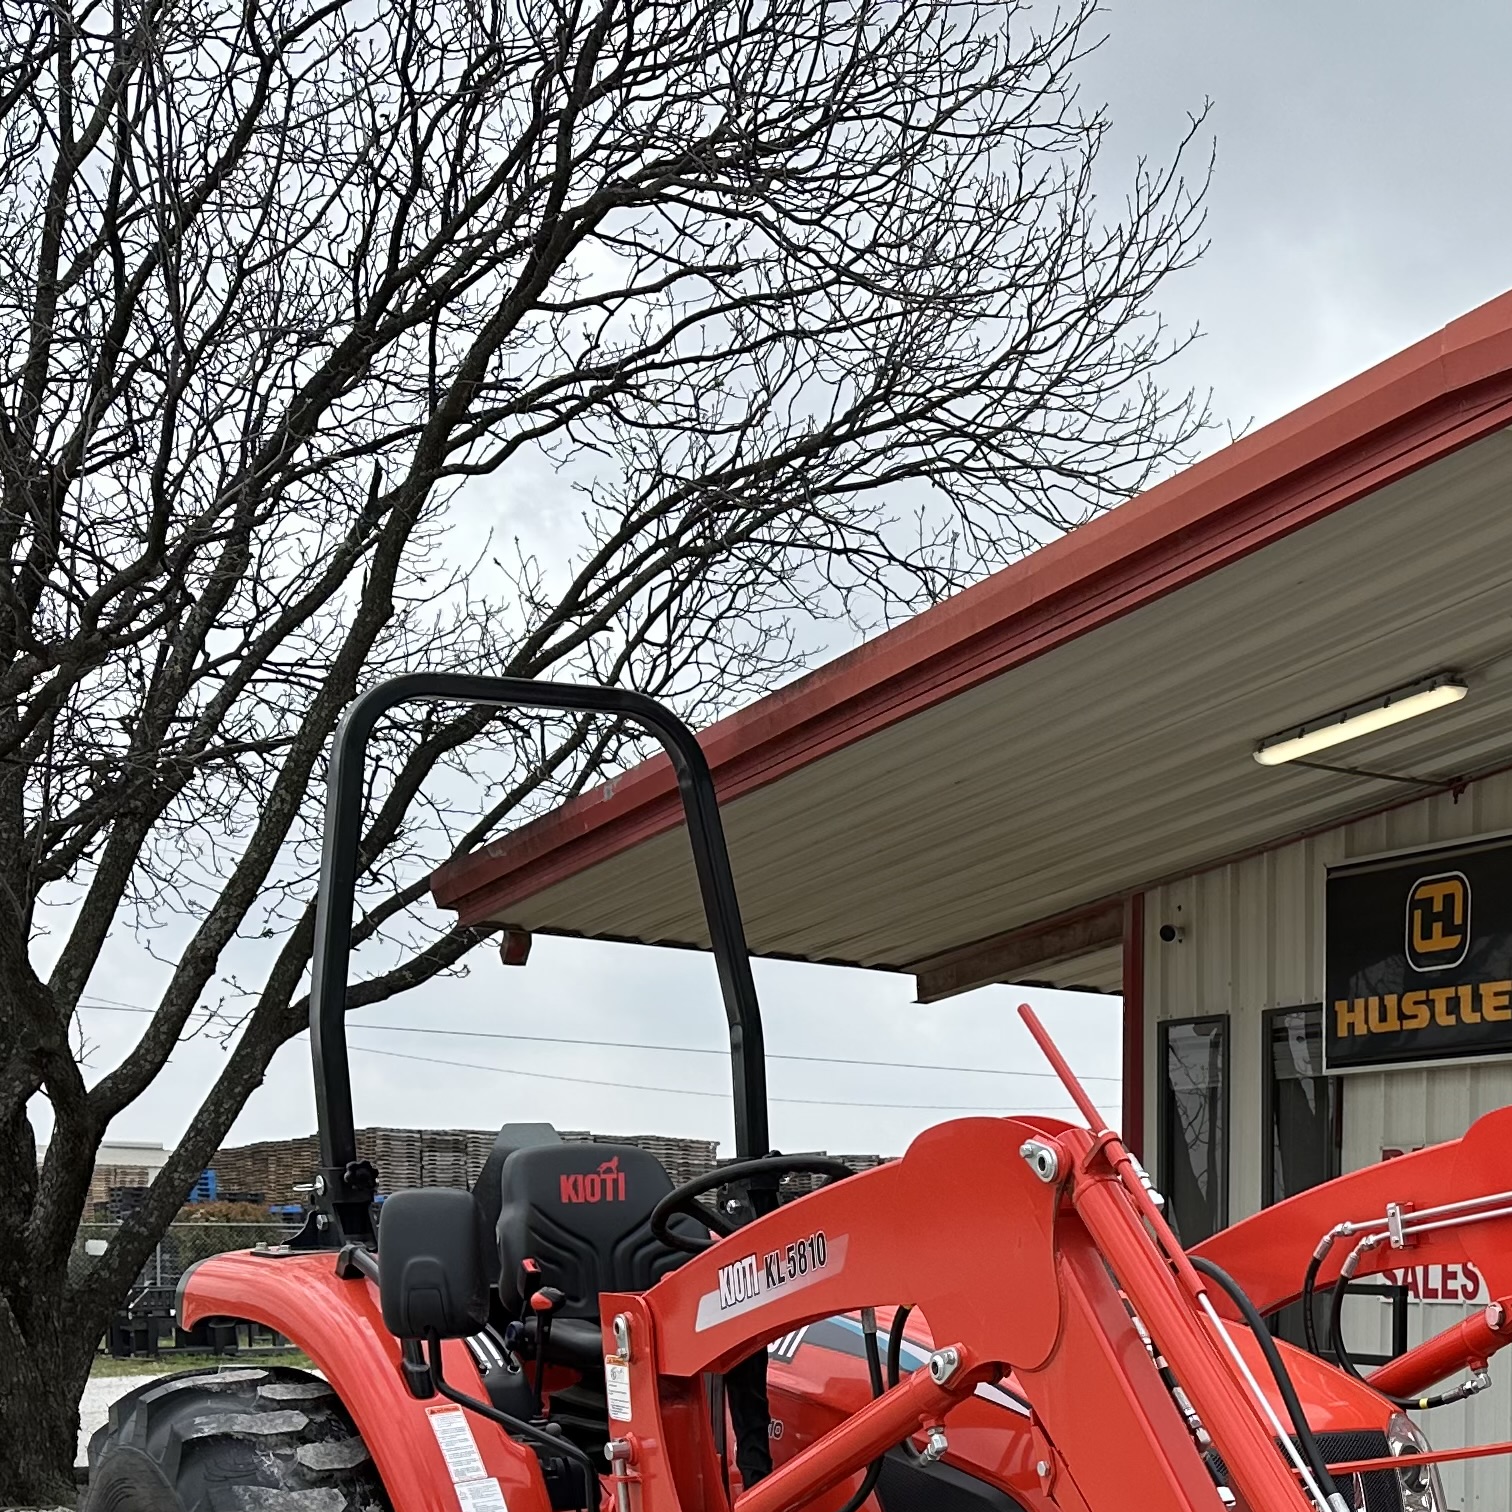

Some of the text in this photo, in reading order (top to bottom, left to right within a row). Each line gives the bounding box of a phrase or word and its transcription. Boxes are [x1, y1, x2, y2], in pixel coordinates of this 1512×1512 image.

[559, 1171, 626, 1204] KIOTI
[718, 1230, 828, 1310] KIOTI KL 5810
